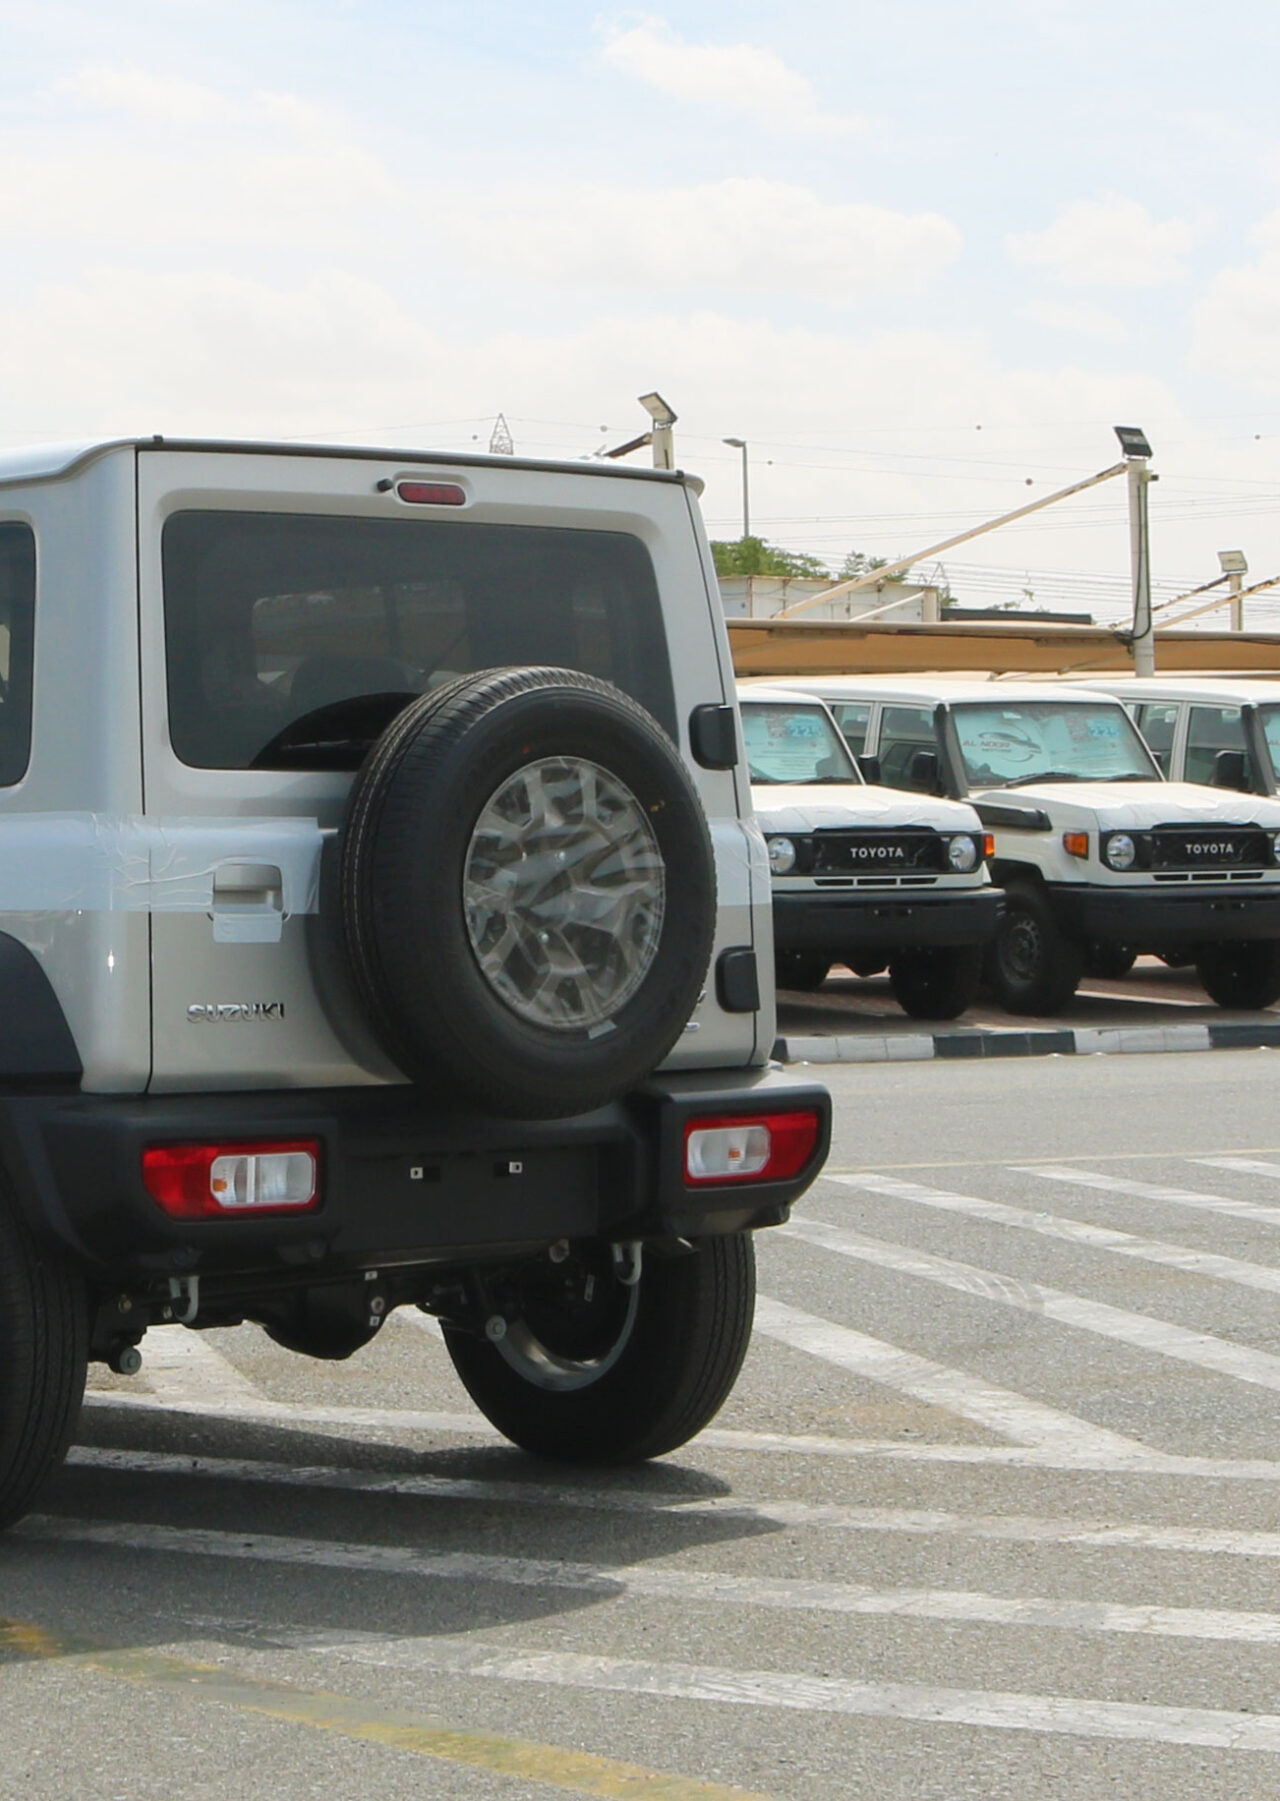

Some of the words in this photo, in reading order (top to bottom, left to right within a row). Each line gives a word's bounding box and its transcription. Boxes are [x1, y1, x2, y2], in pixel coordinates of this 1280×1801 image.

[850, 847, 905, 859] TOYOTA
[1184, 843, 1234, 855] TOYOTA
[186, 1002, 285, 1023] SUZUKI
